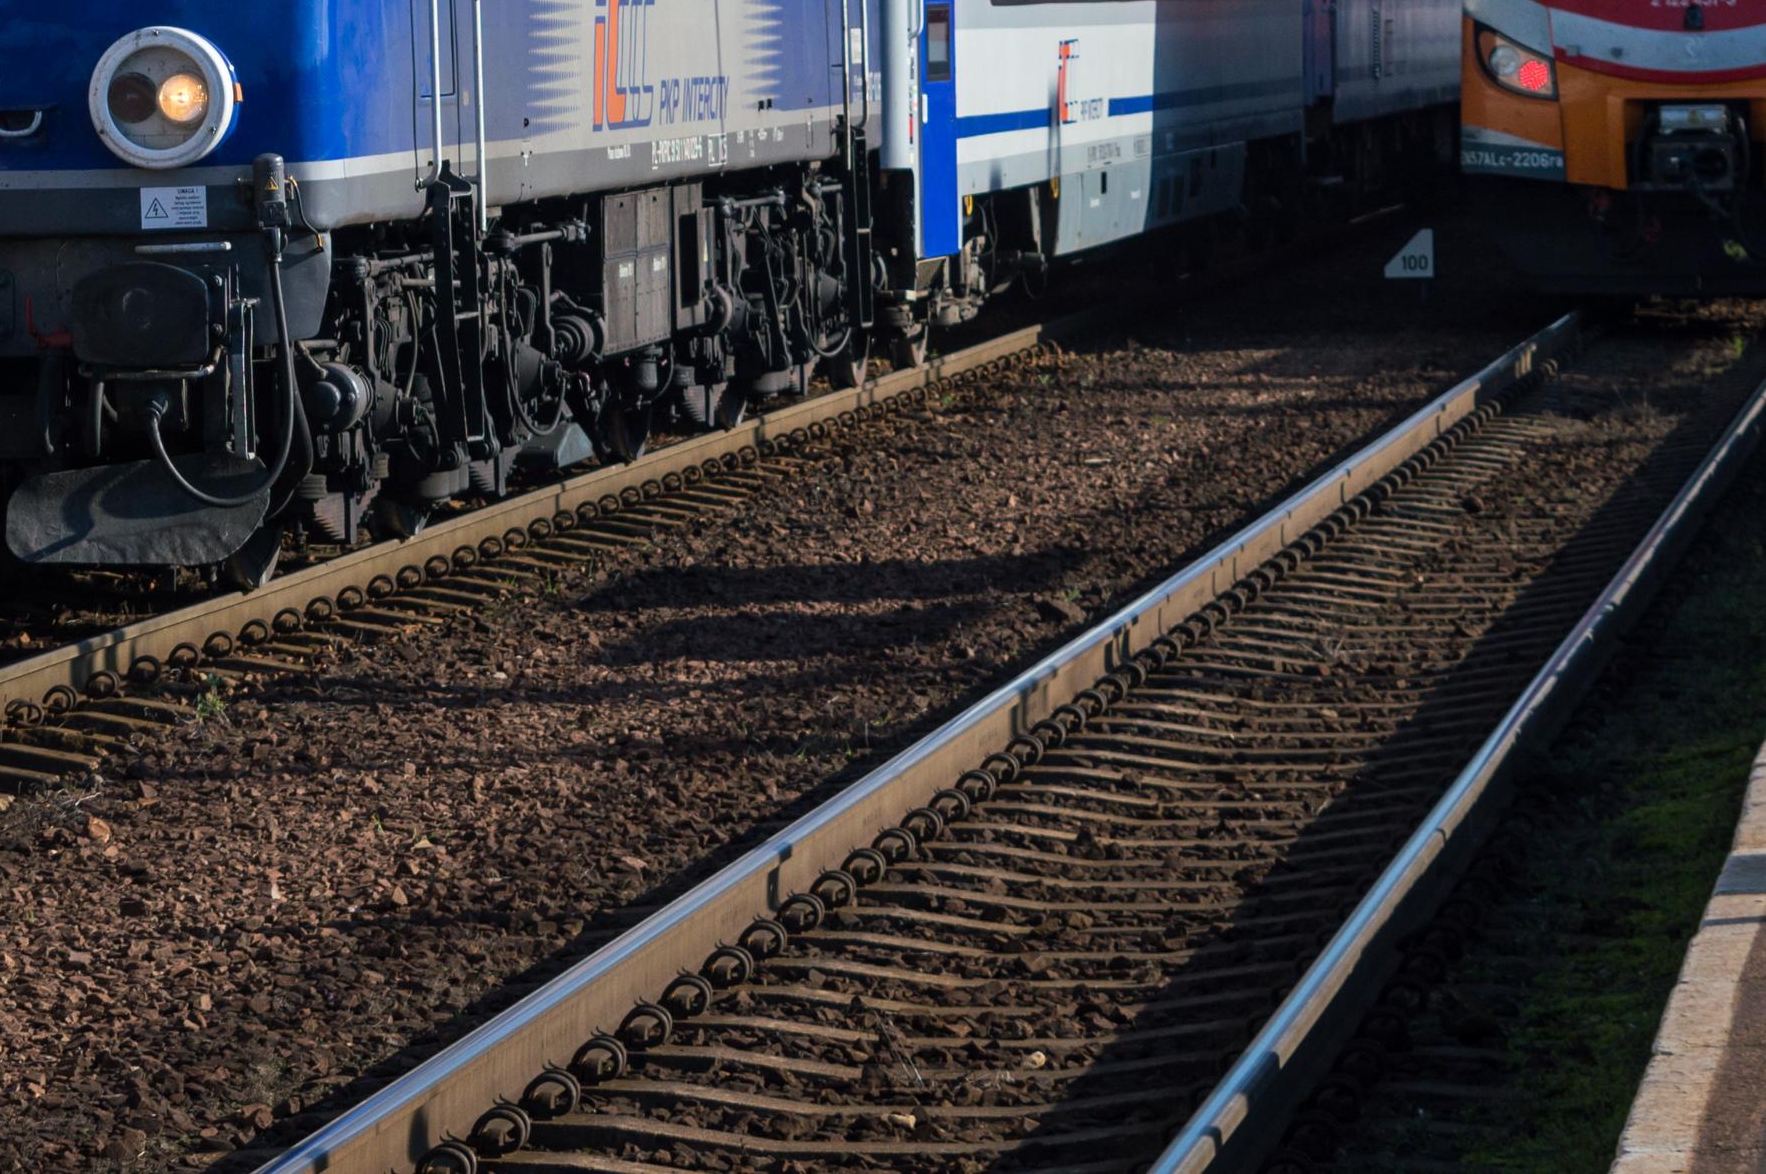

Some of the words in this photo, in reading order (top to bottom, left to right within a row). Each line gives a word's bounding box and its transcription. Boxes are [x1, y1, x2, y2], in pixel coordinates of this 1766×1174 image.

[659, 78, 680, 126] PKP
[682, 75, 730, 124] INTERCITY
[1401, 254, 1429, 272] 100
